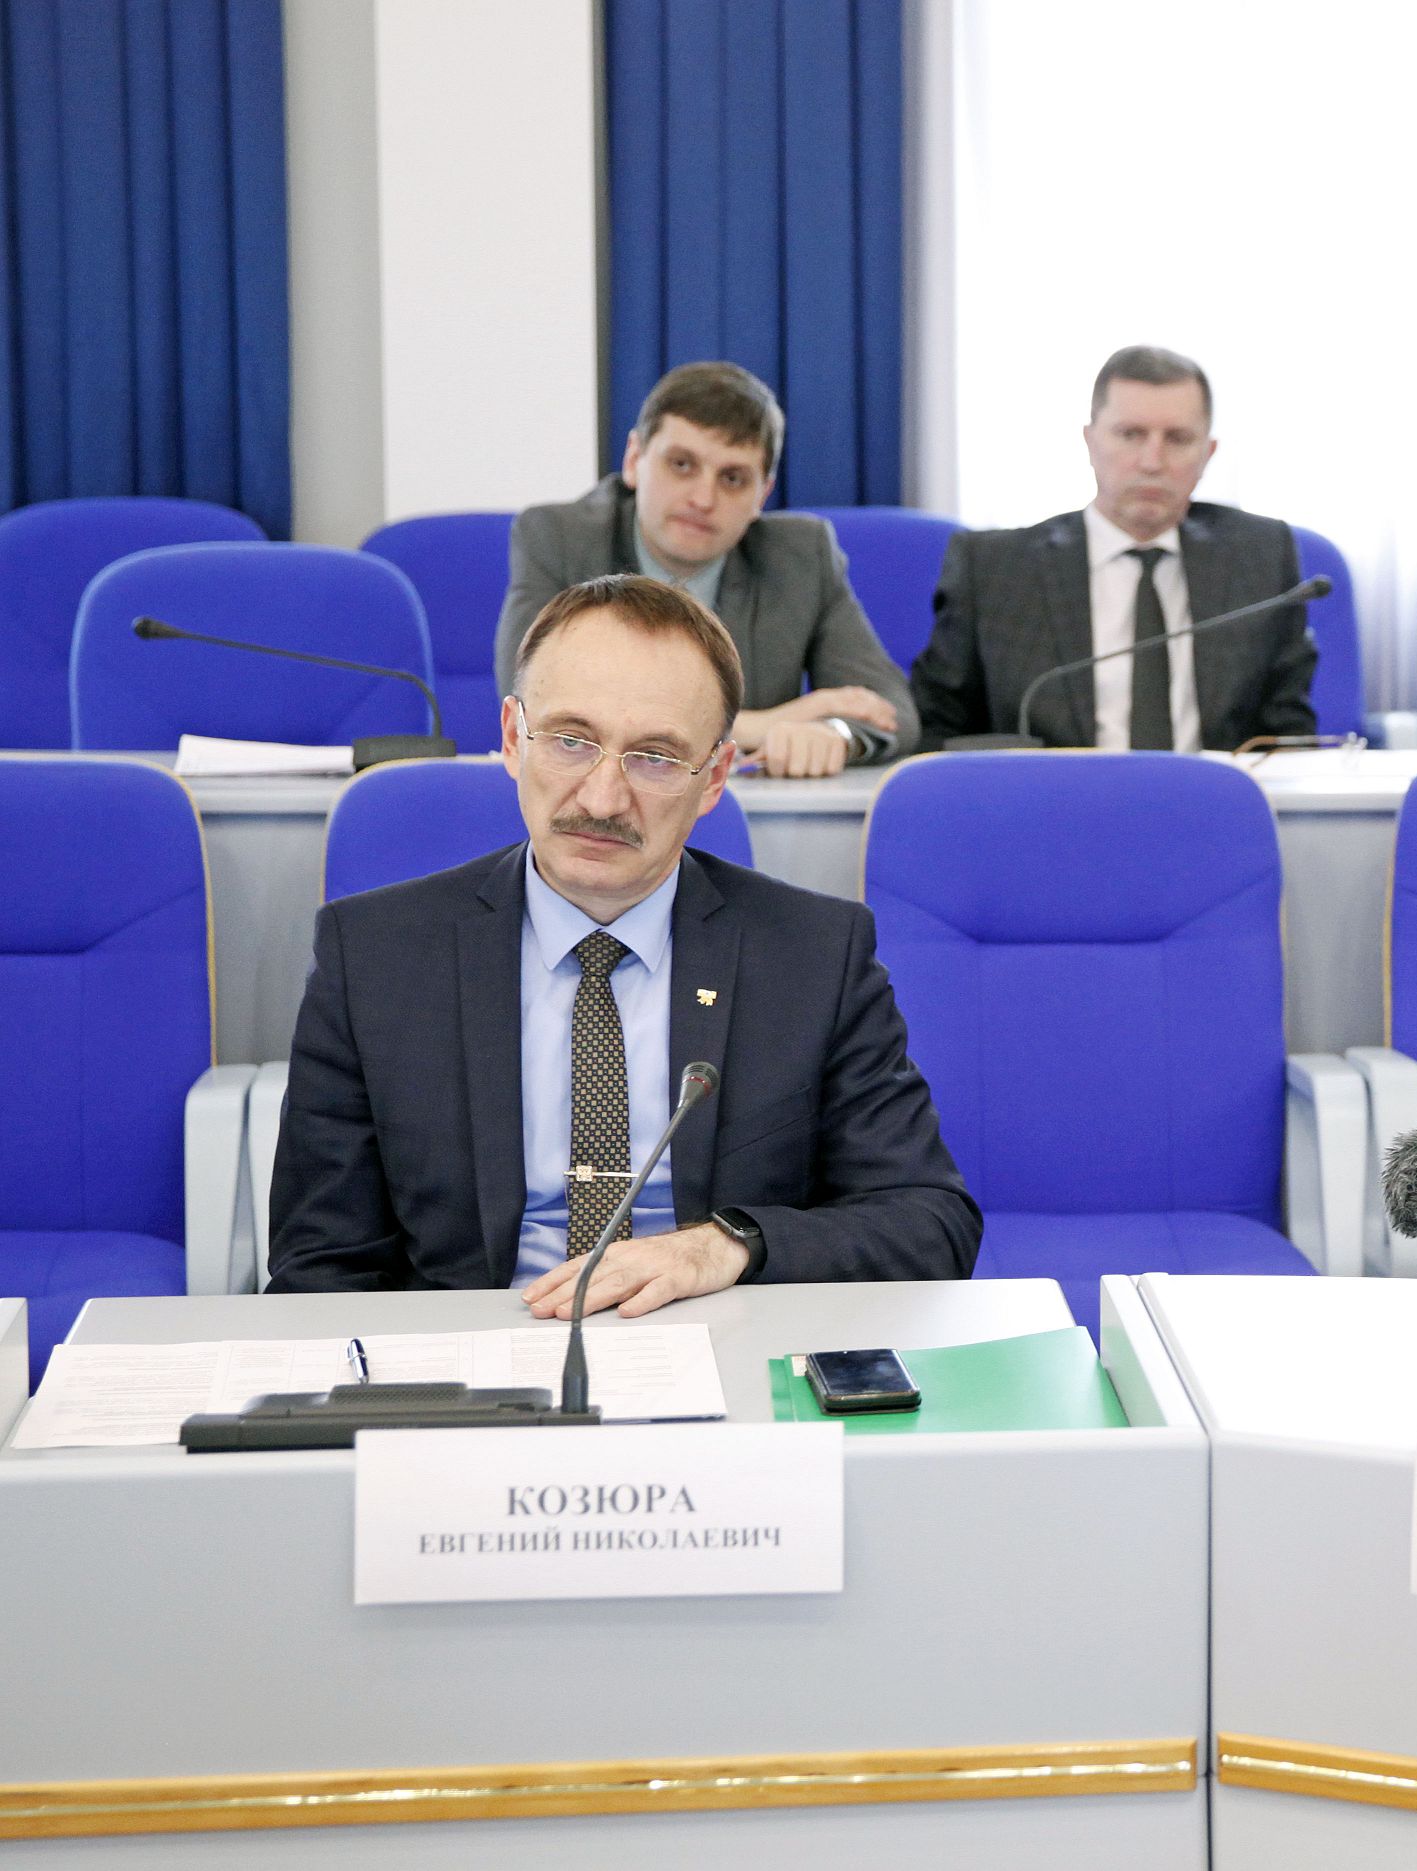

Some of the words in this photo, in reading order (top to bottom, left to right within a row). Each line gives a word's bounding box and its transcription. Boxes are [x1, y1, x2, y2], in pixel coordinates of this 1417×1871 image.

[507, 1484, 697, 1516] КОЗЮРА
[419, 1526, 561, 1554] ЕВГЕНИЙ
[572, 1527, 782, 1552] НИКОЛАЕВИЧ
